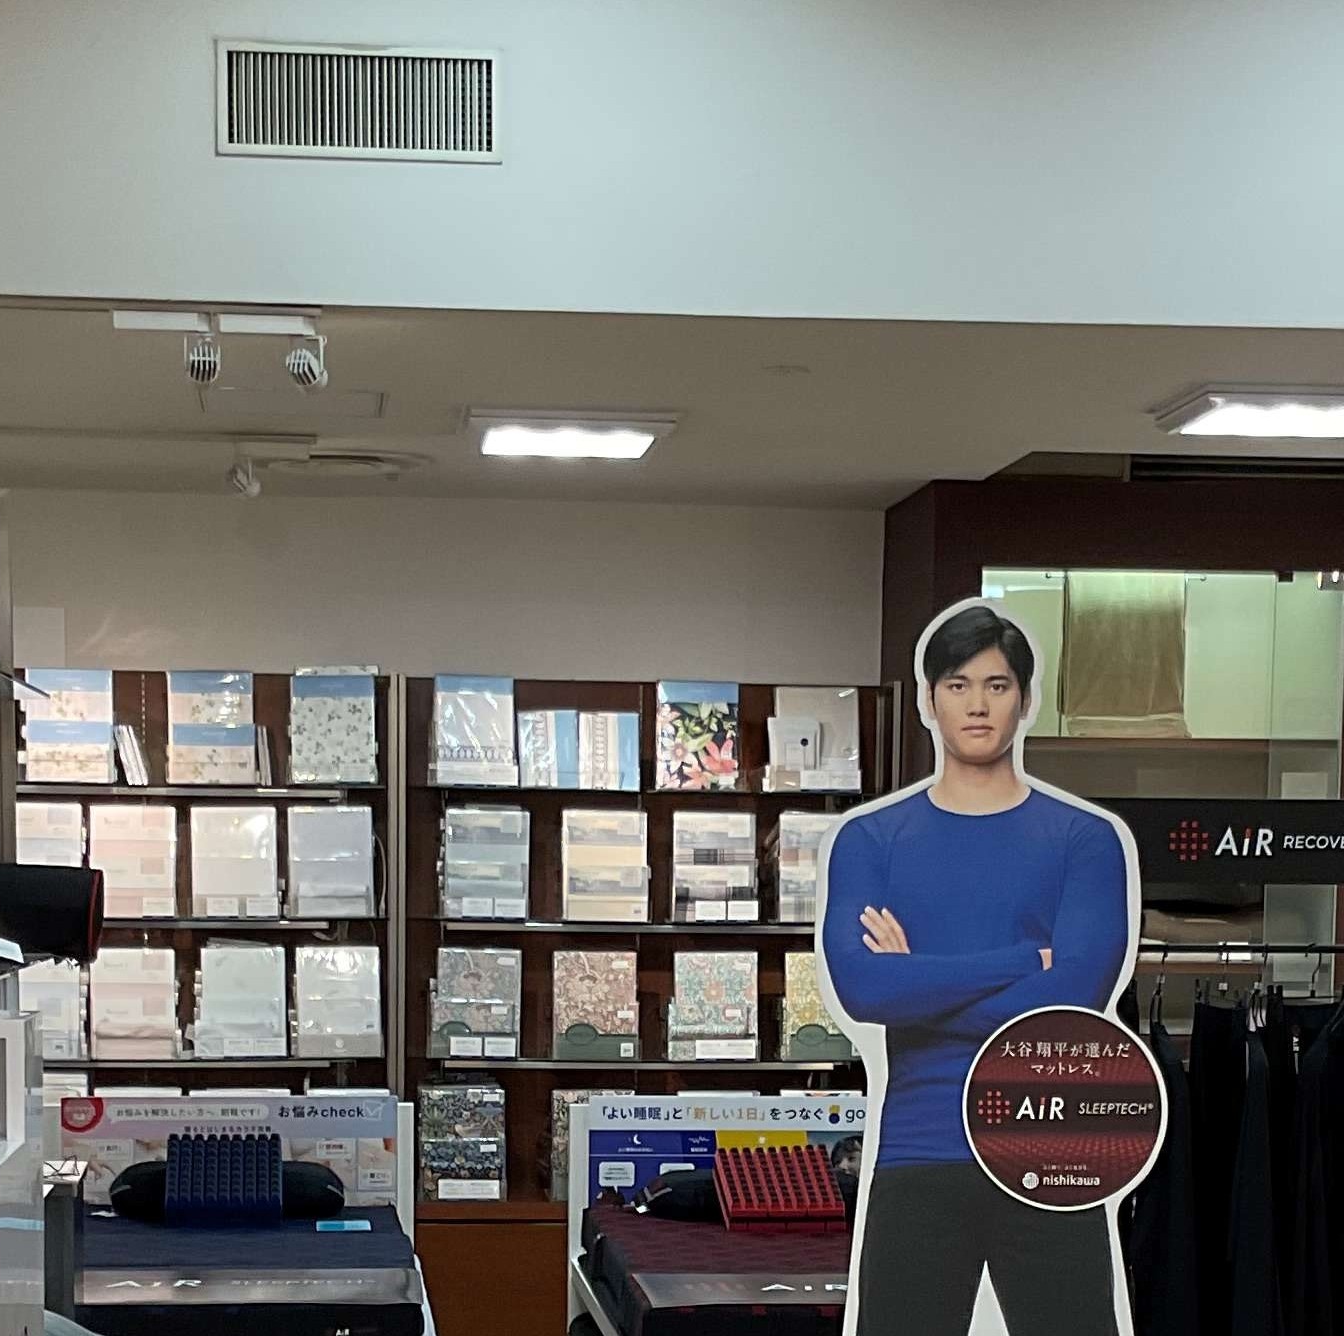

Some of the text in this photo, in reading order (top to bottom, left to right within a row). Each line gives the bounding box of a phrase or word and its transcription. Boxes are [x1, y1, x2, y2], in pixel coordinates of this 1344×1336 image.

[1030, 1062, 1101, 1077] マットレス。
[1042, 1174, 1101, 1187] nishikawa
